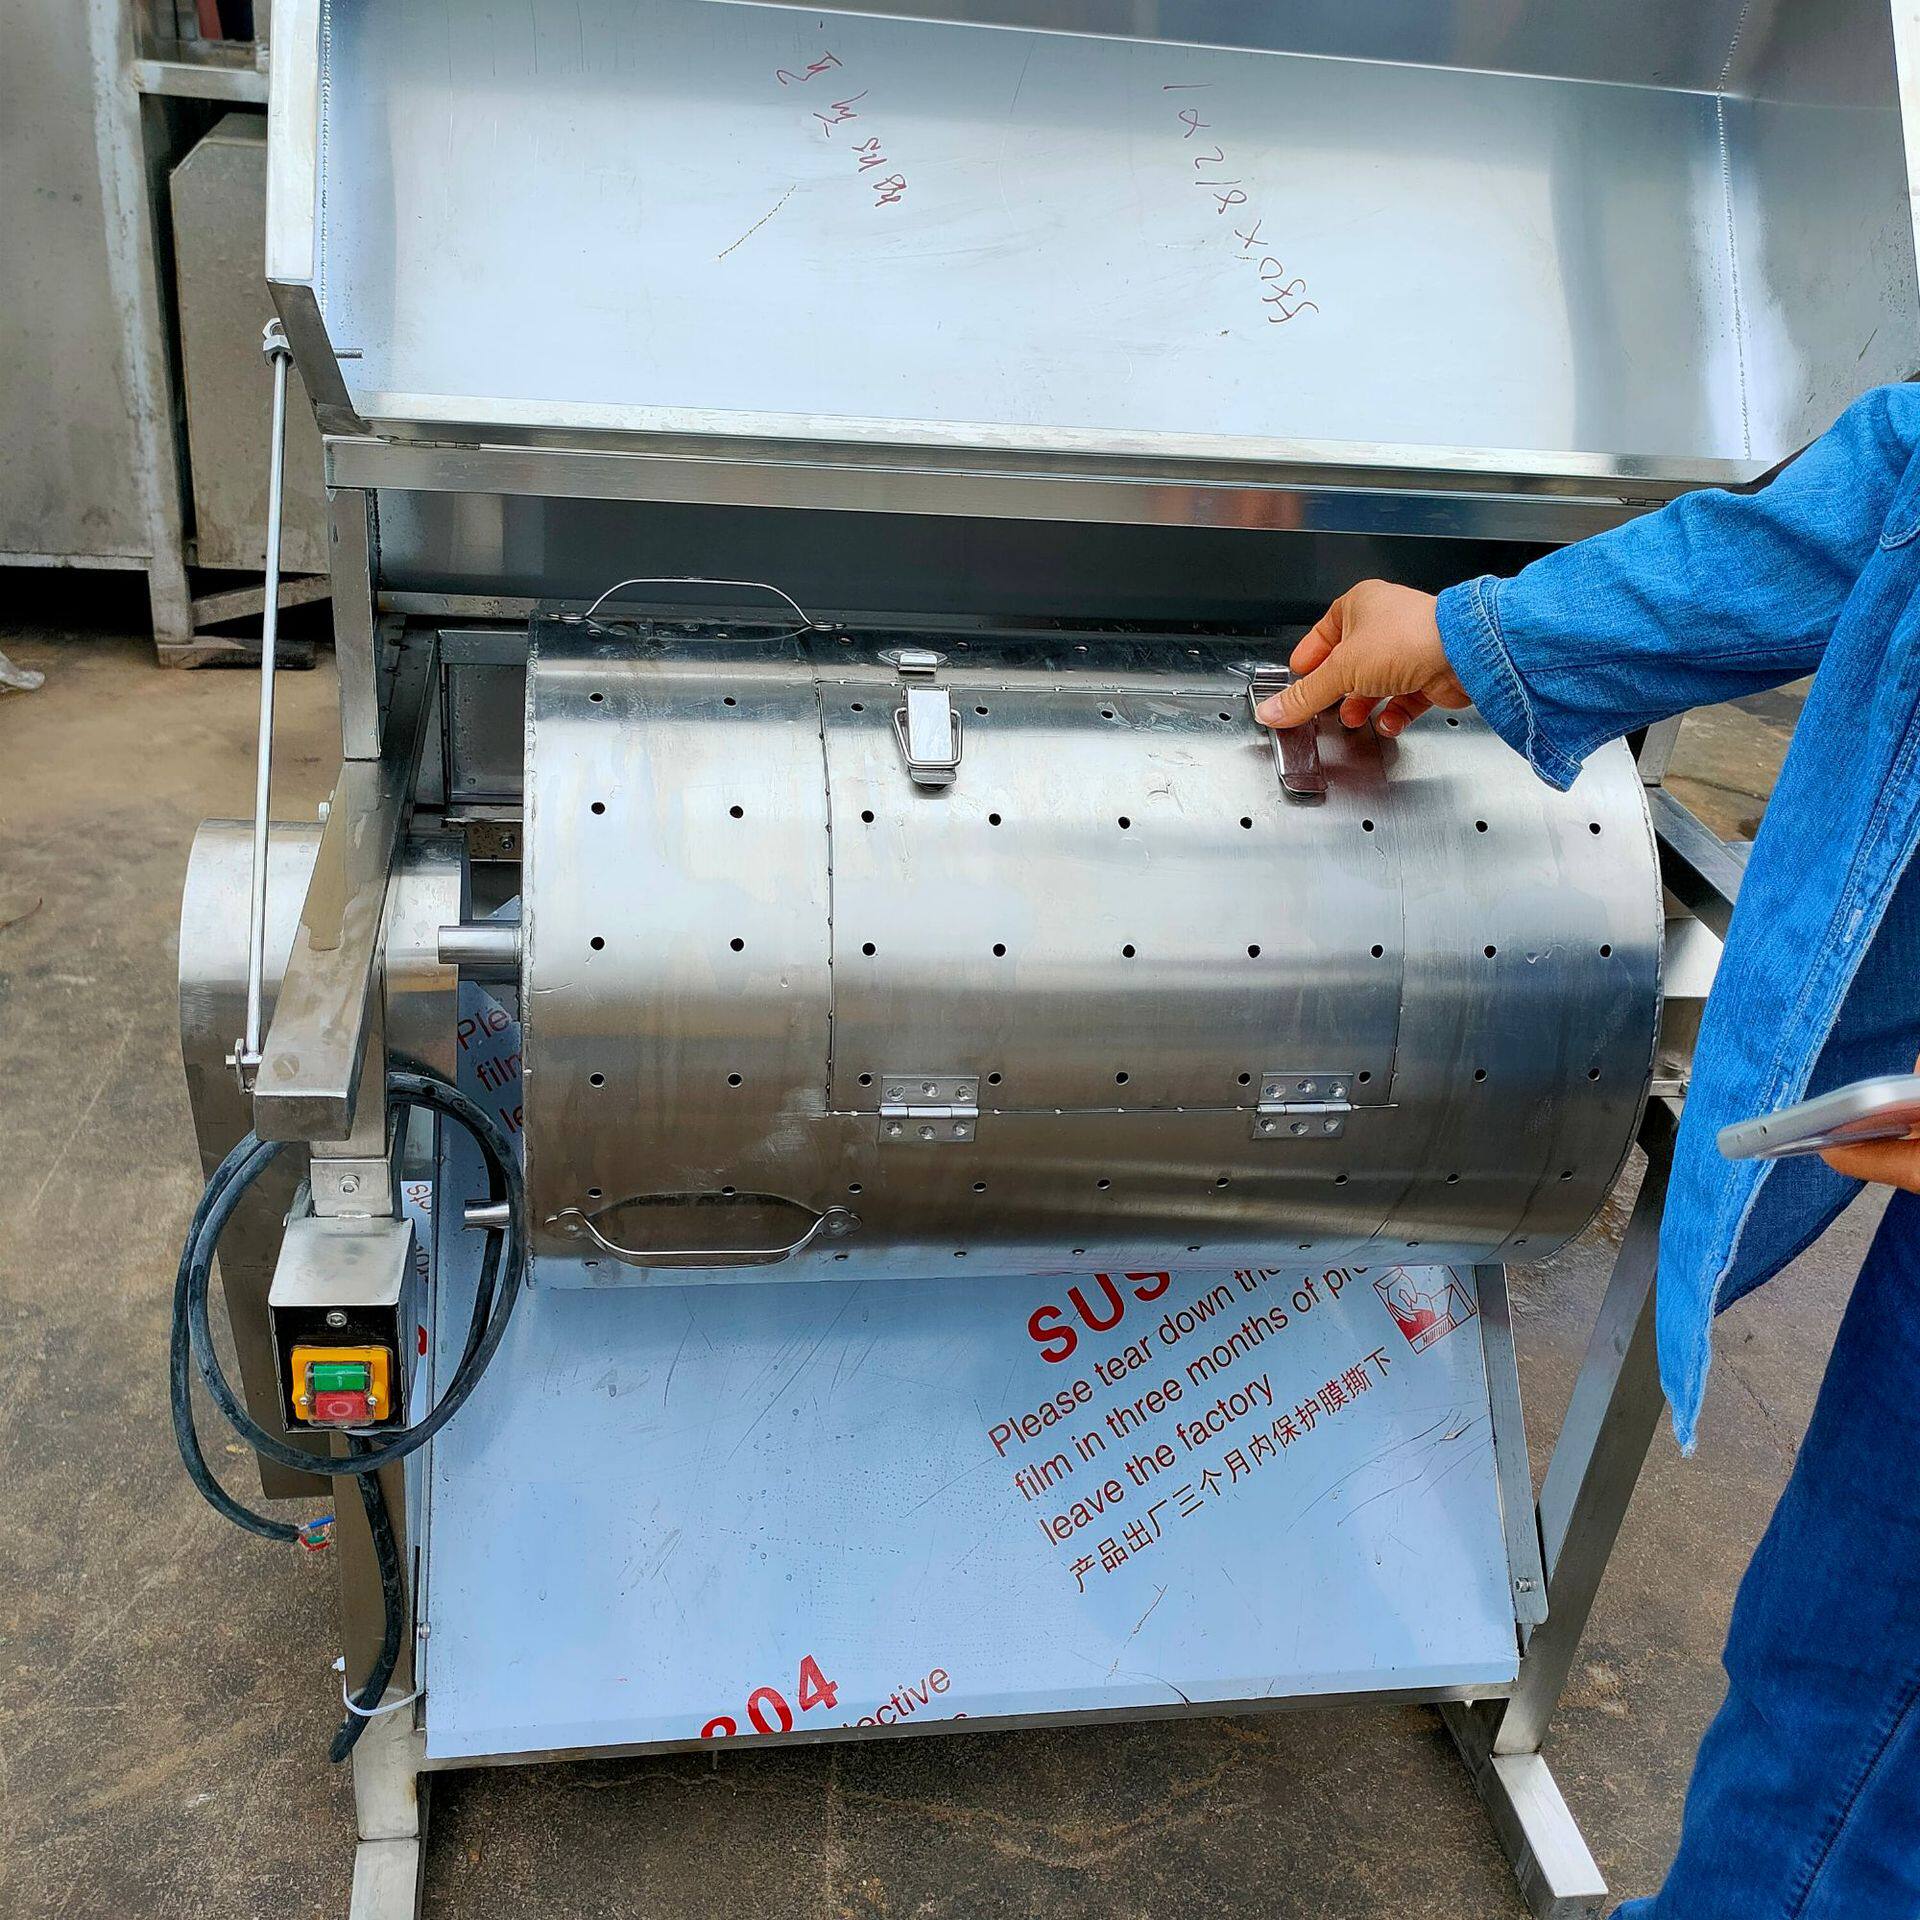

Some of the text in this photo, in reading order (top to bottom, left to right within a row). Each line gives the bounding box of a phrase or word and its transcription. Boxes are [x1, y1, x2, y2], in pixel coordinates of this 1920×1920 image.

[987, 1379, 1094, 1458] Please
[1093, 1335, 1153, 1387] tear
[1158, 1285, 1236, 1346] down
[1013, 1452, 1074, 1502] film
[1070, 1430, 1107, 1463] in
[1105, 1378, 1184, 1439] three
[1185, 1306, 1289, 1387] months
[1291, 1275, 1321, 1313] of
[1039, 1372, 1275, 1547] leave the factory
[1068, 1345, 1393, 1594] 产品出厂三个月内保护膜撕下
